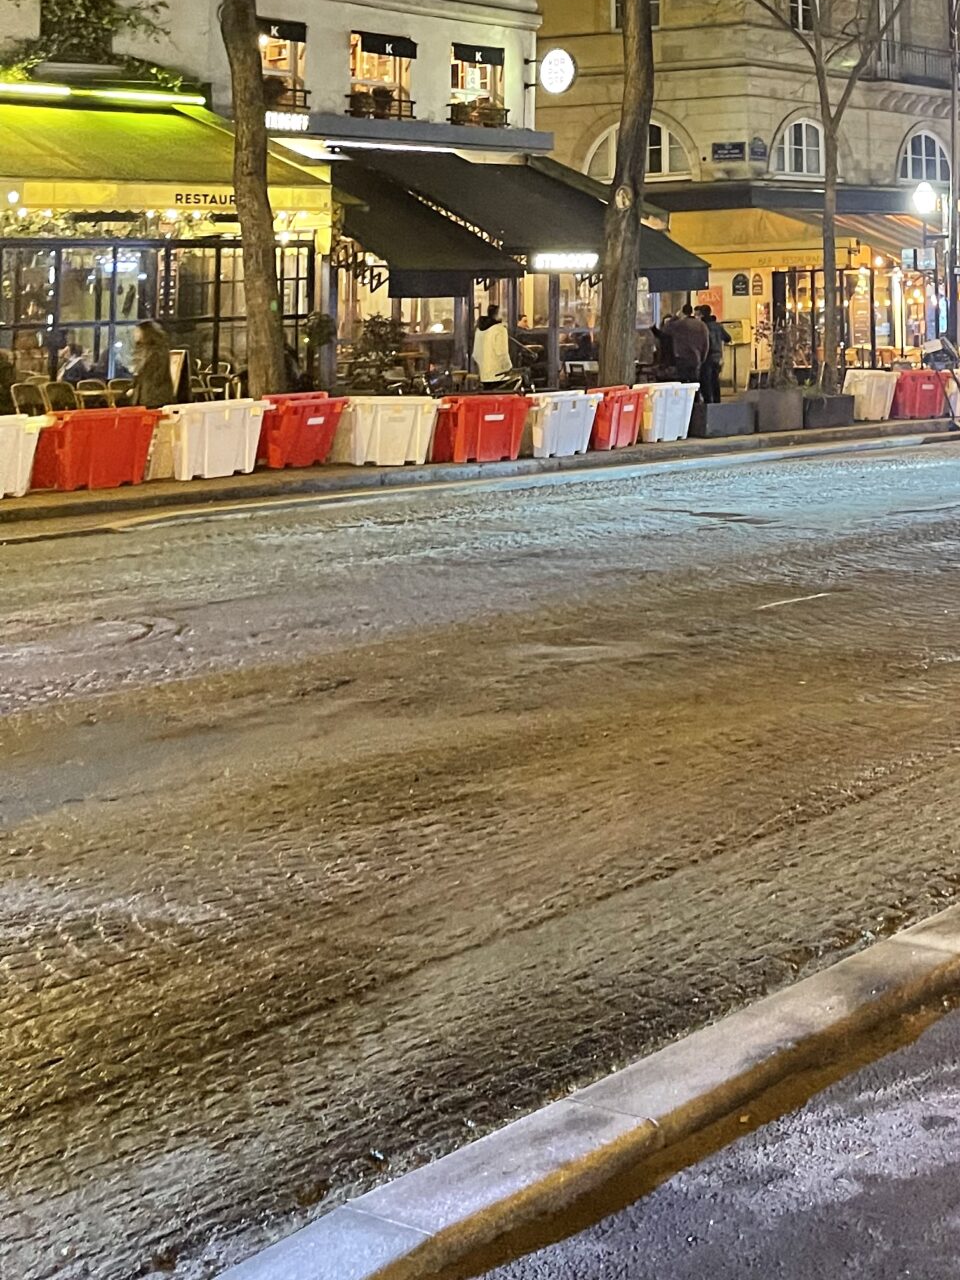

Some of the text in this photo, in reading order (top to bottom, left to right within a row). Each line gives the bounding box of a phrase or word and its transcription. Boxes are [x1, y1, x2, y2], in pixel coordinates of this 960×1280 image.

[270, 25, 279, 37] K
[385, 43, 393, 54] K
[475, 51, 482, 62] K
[175, 193, 236, 205] RESTAUR
